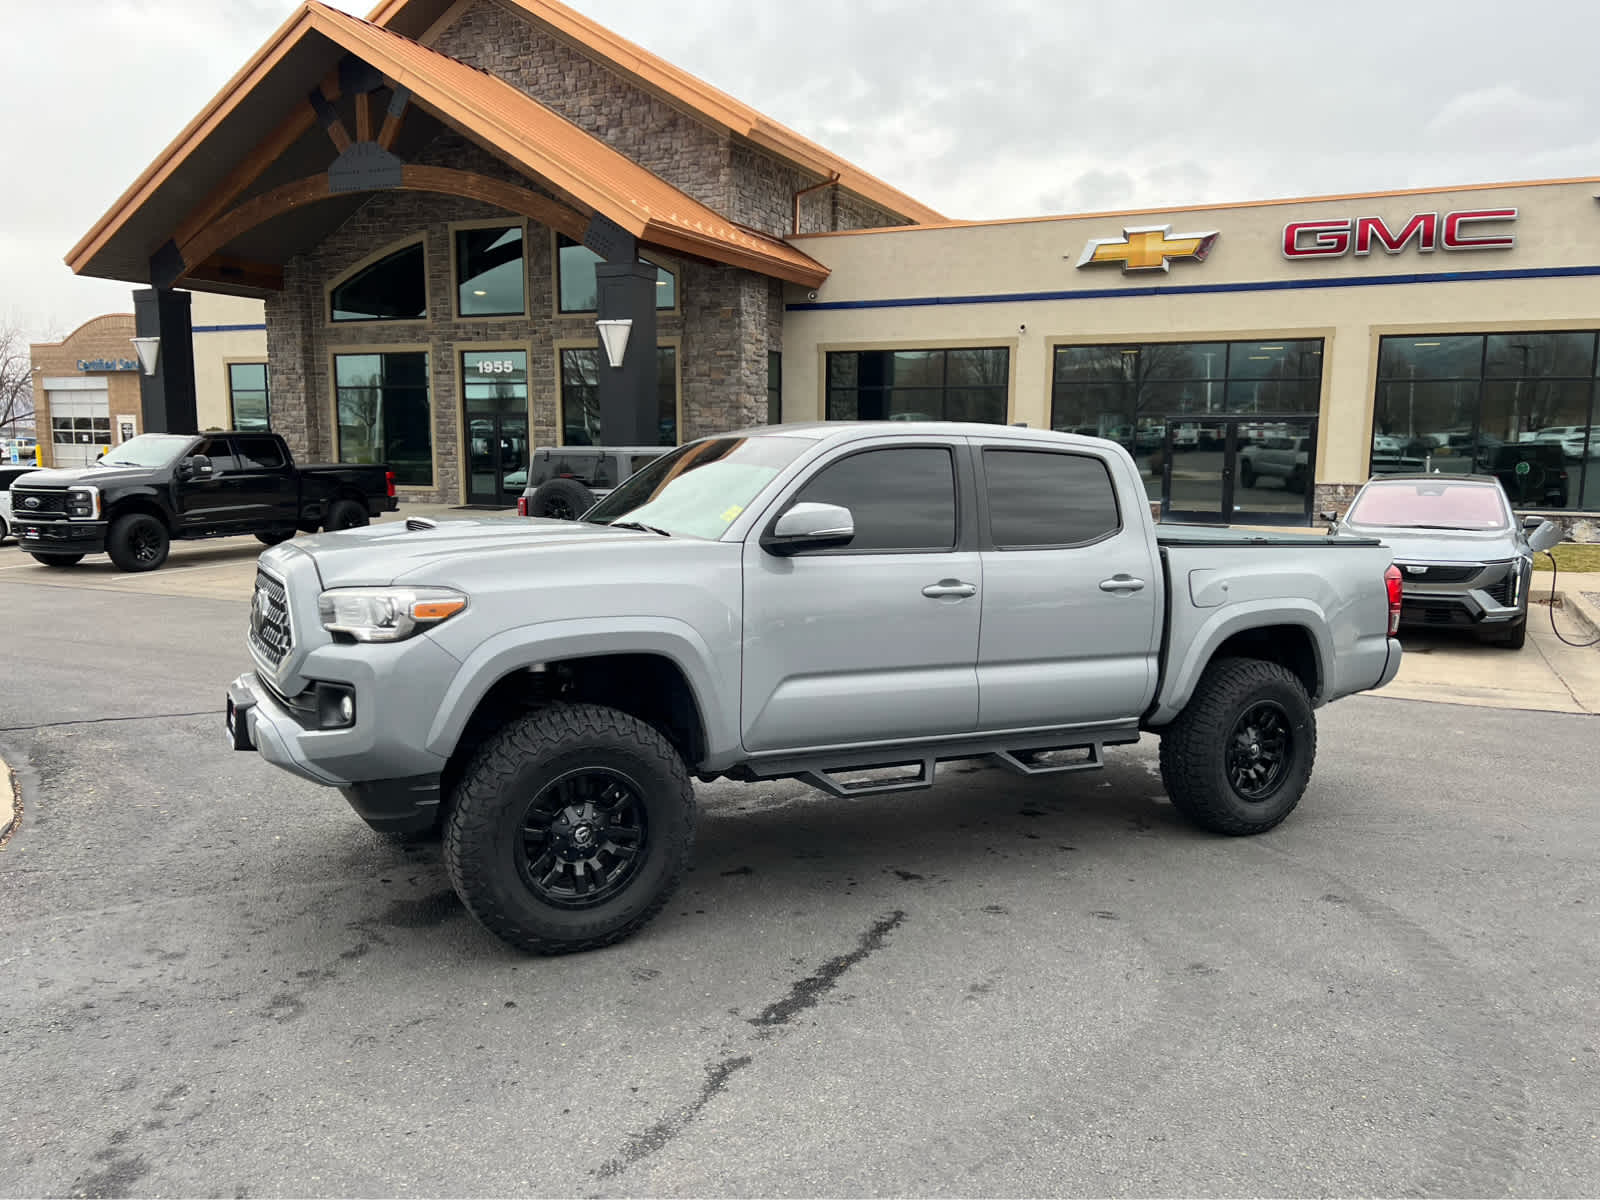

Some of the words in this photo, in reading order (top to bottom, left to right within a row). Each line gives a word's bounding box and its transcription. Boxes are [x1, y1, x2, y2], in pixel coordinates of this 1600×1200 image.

[1282, 207, 1518, 259] GMC
[77, 359, 117, 371] Certified
[476, 360, 513, 373] 1955
